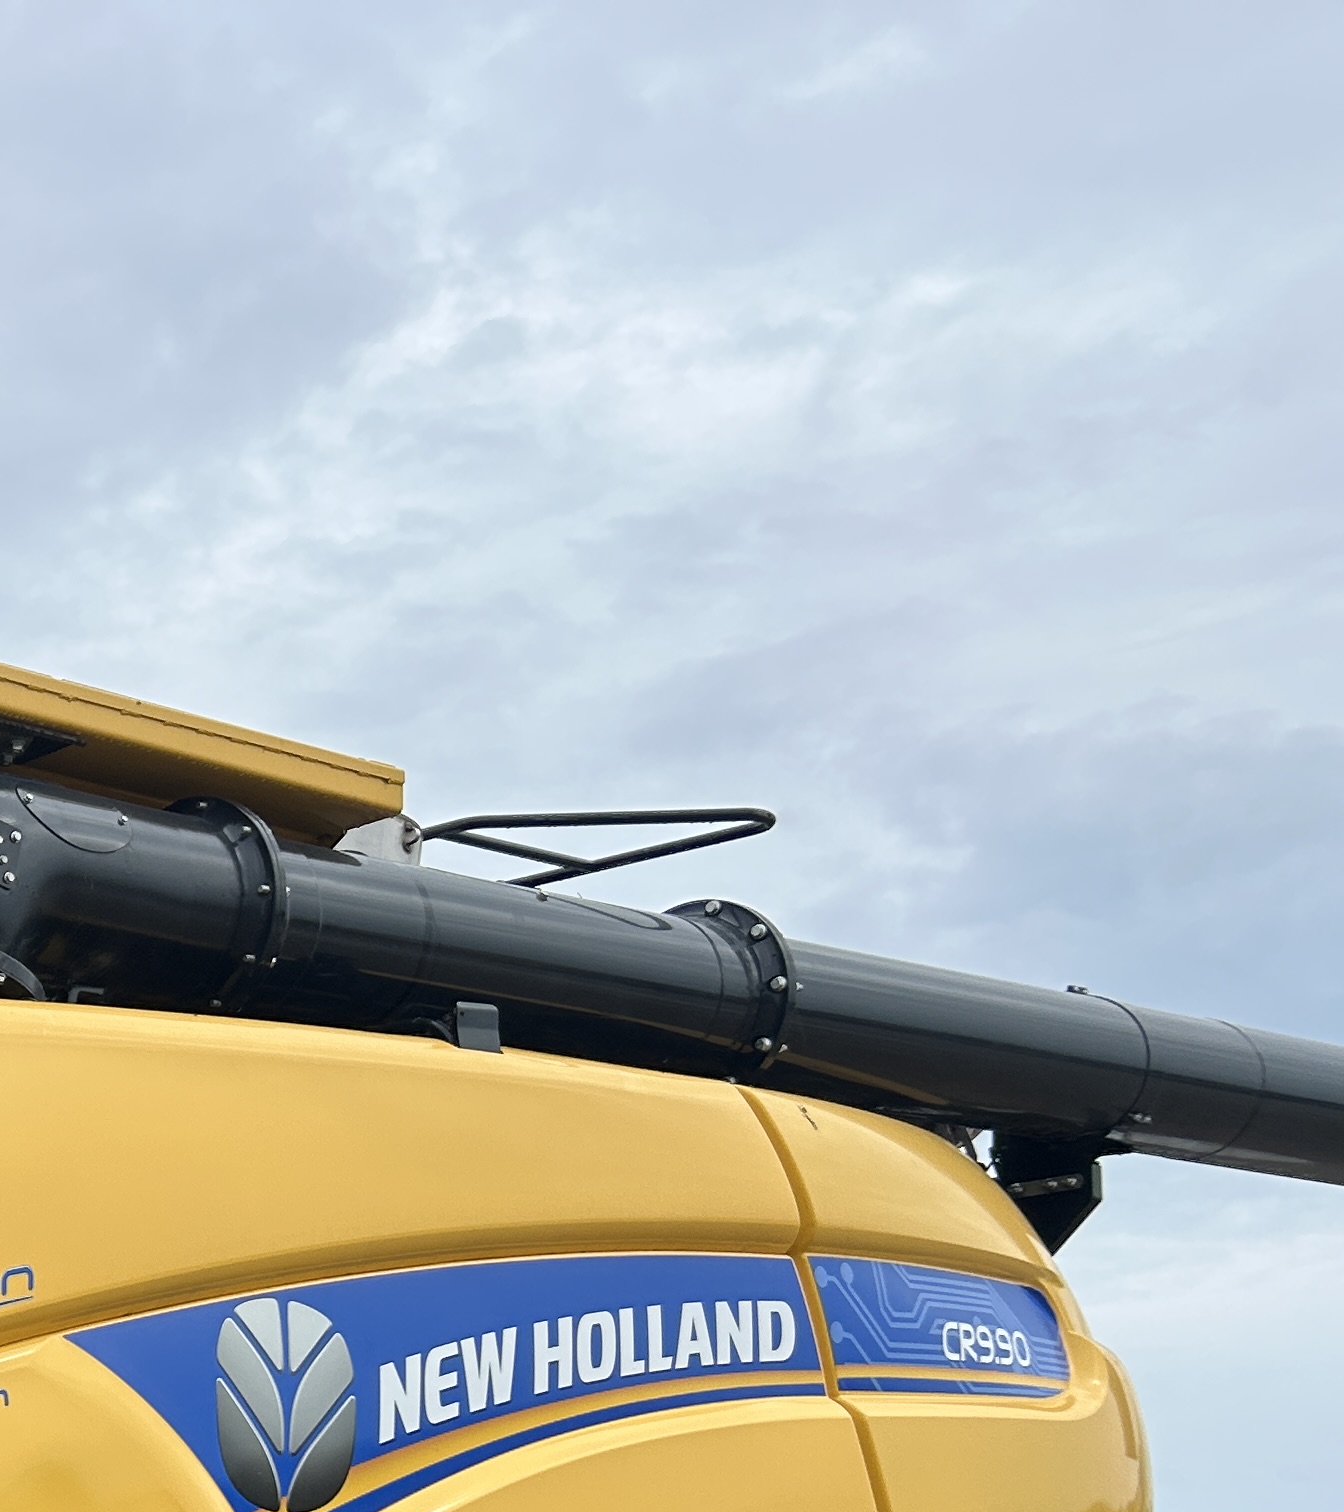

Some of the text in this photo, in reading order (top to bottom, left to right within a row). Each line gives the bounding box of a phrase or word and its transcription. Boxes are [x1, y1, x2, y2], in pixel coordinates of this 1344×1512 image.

[378, 1299, 796, 1444] NEW HOLLAND
[942, 1321, 1031, 1367] CR9.90
